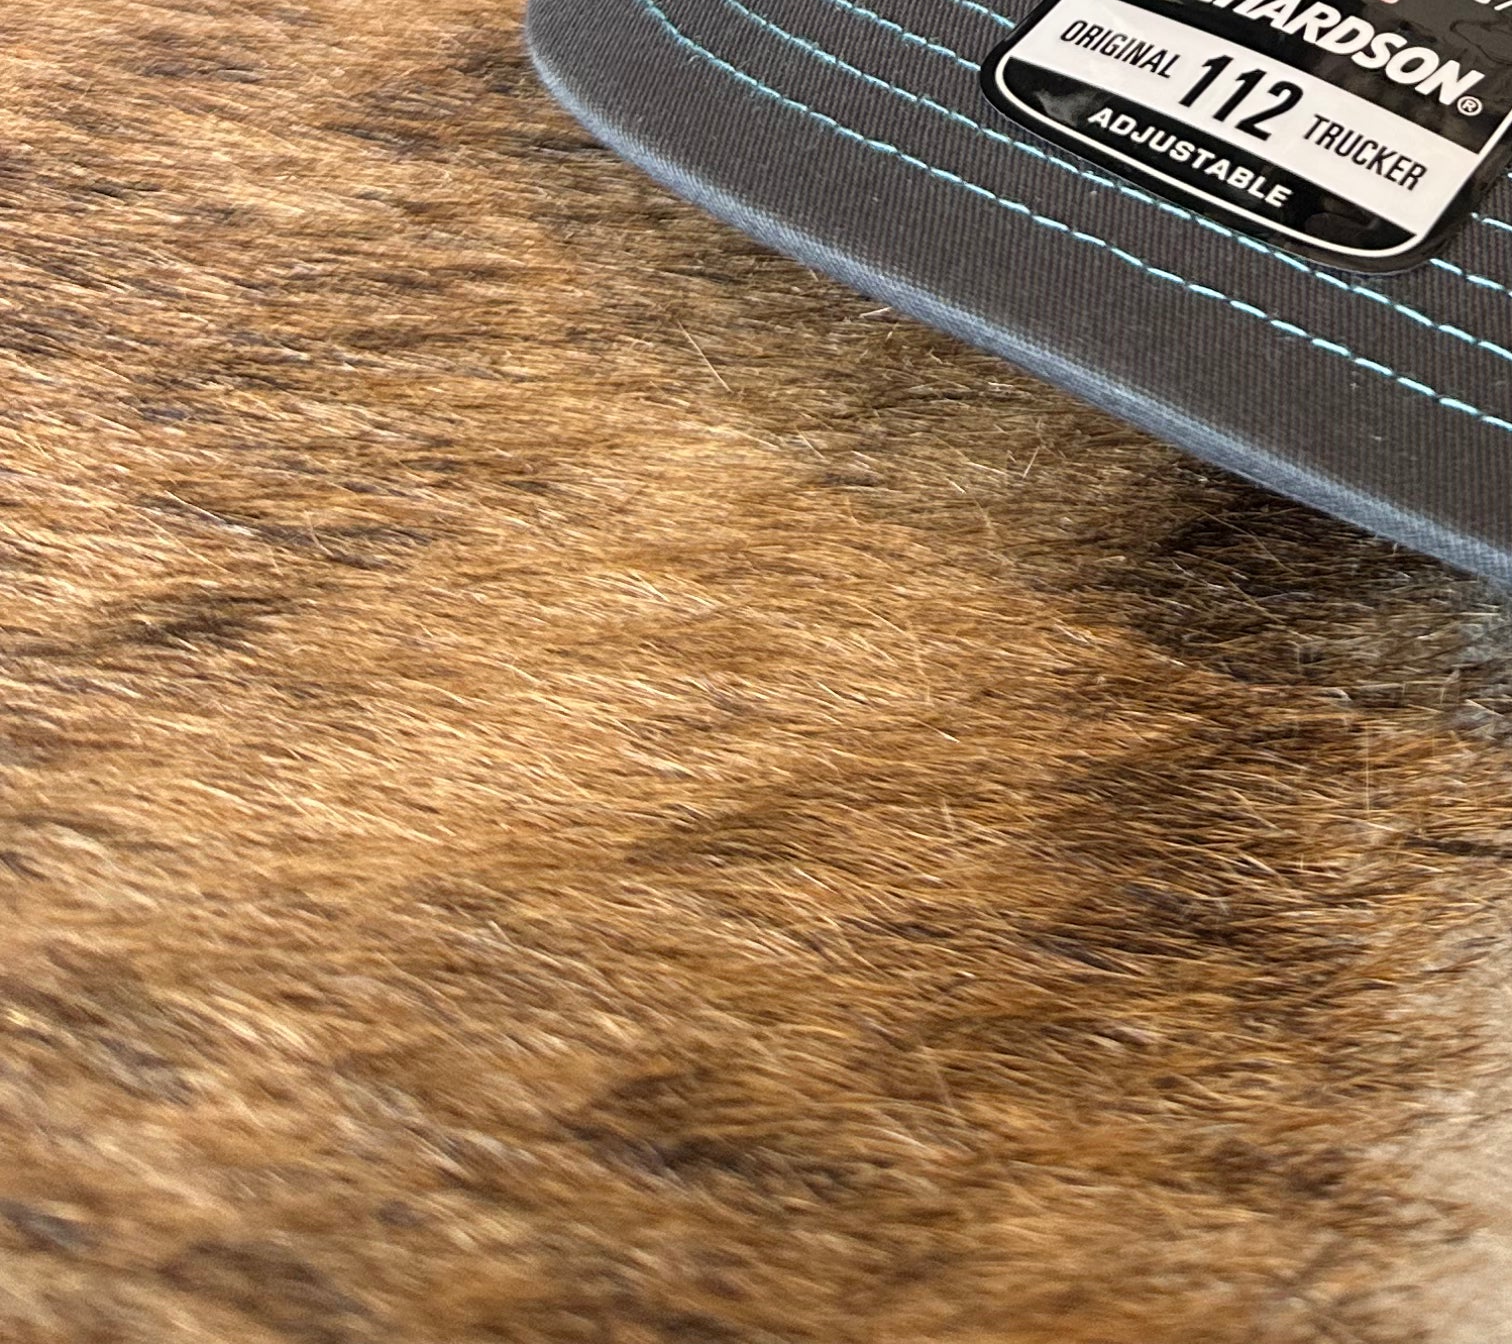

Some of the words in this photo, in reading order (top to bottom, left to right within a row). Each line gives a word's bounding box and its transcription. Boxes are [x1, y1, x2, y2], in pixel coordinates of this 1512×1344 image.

[1060, 19, 1184, 79] ORIGINAL
[1180, 53, 1304, 141] 112
[1302, 113, 1428, 191] TRUCKER
[1088, 106, 1293, 209] ADJUSTABLE
